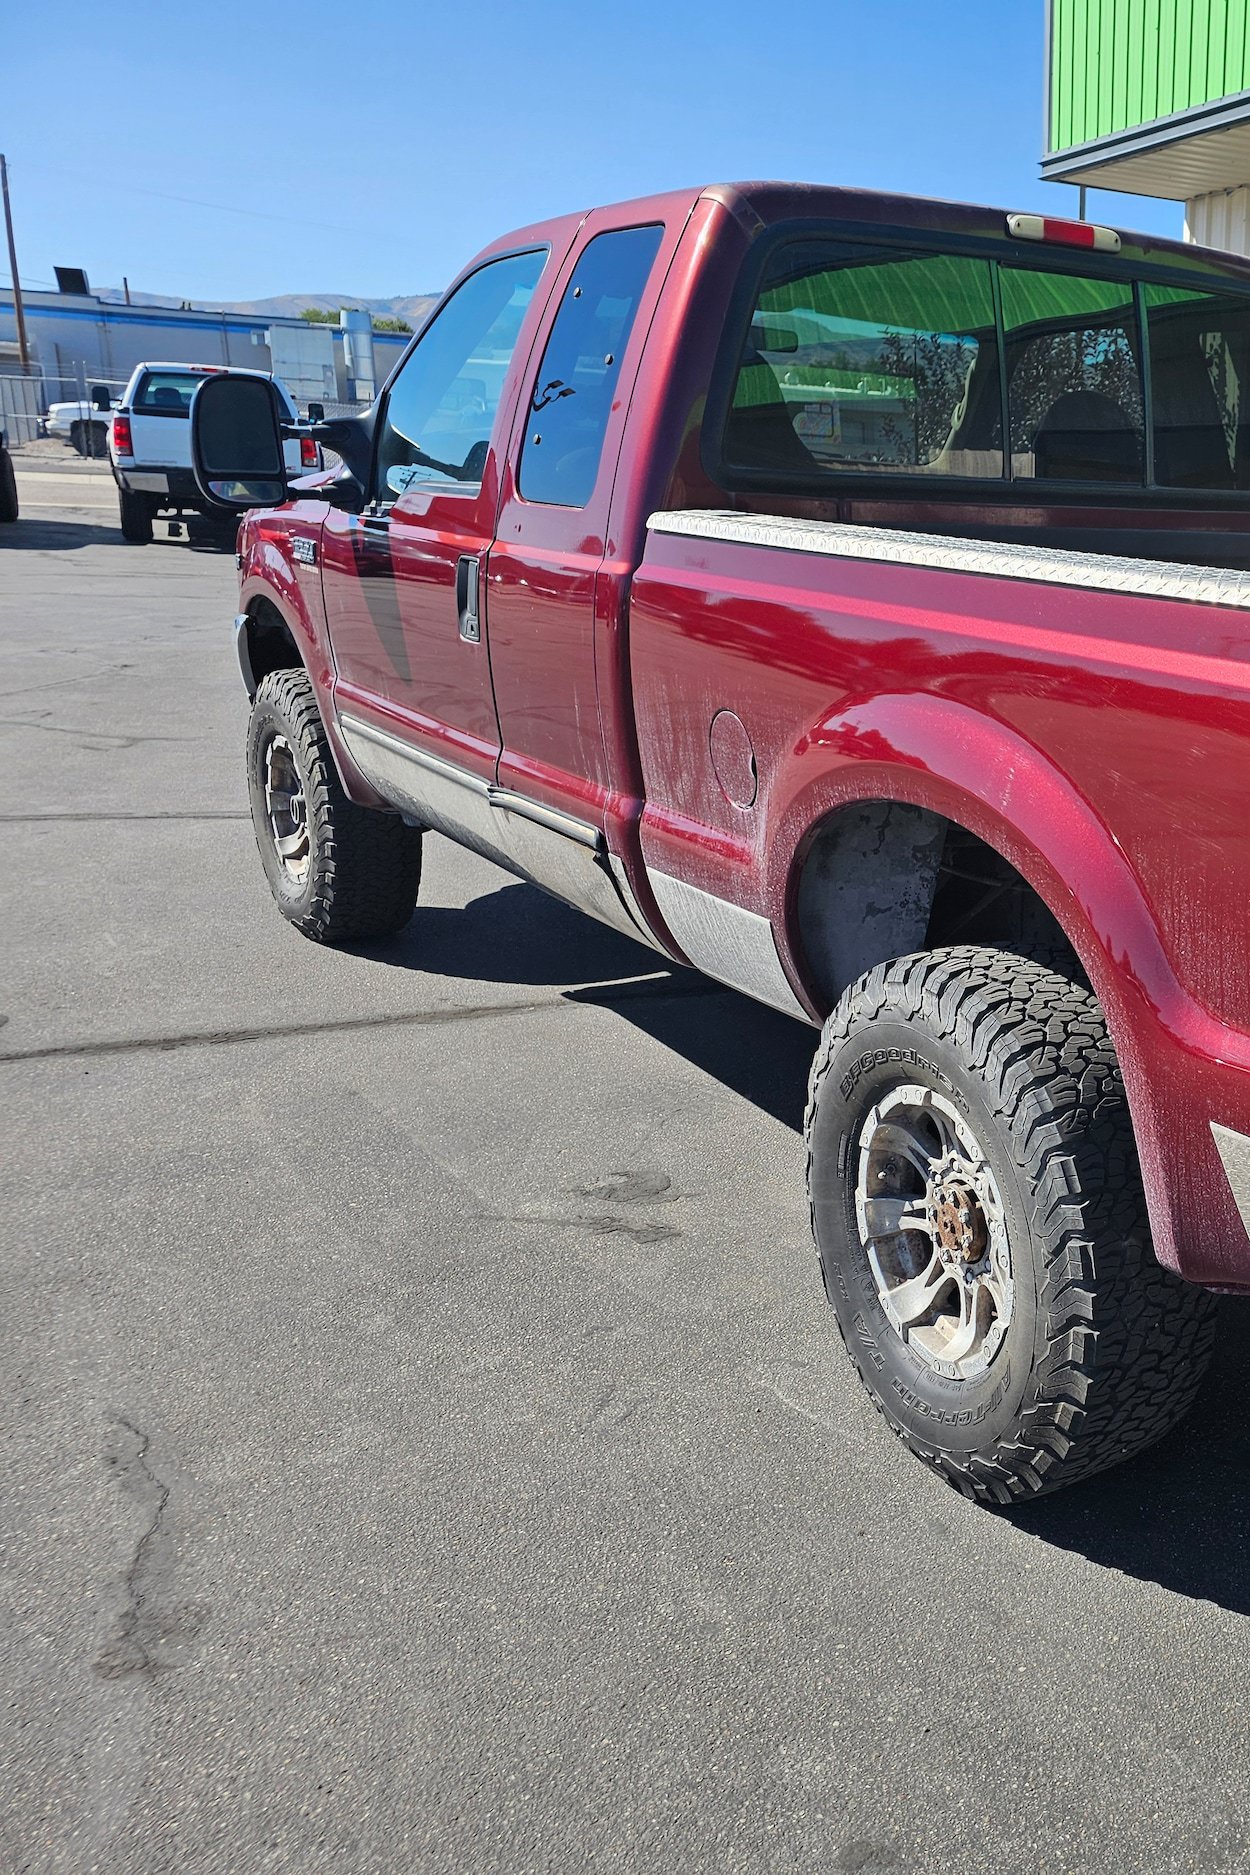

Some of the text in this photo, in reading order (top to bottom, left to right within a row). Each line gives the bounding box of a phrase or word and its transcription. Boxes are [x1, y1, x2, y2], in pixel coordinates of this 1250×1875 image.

[839, 1046, 970, 1114] BFGoodrich
[853, 1311, 888, 1373] T/A
[892, 1358, 1012, 1427] All-Terrain
